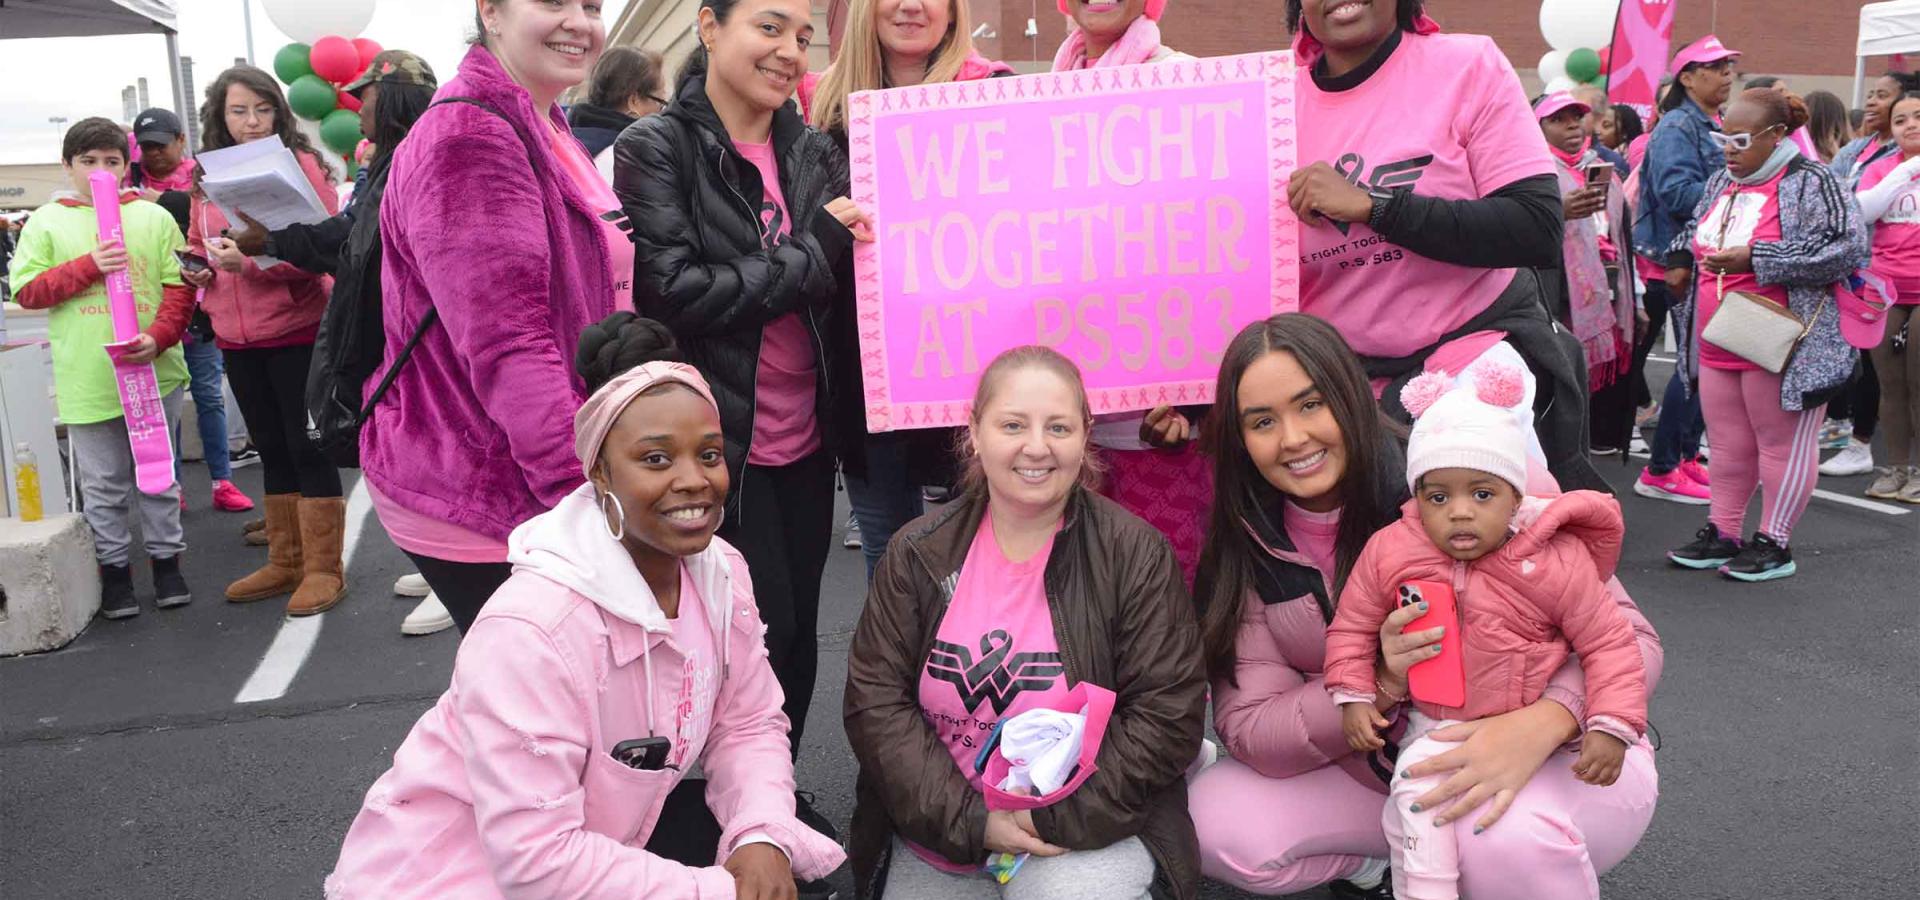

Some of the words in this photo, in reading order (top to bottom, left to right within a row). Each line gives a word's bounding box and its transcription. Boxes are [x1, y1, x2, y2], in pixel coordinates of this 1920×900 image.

[896, 118, 1010, 201] WE
[1049, 98, 1245, 190] FIGHT
[887, 194, 1252, 295] TOGETHER
[1311, 243, 1347, 262] FIGHT
[1352, 233, 1387, 250] TOGE
[1374, 249, 1404, 265] 583
[911, 297, 990, 380] AT
[1033, 286, 1235, 374] PS583
[123, 373, 144, 418] essen
[973, 718, 997, 731] TOG
